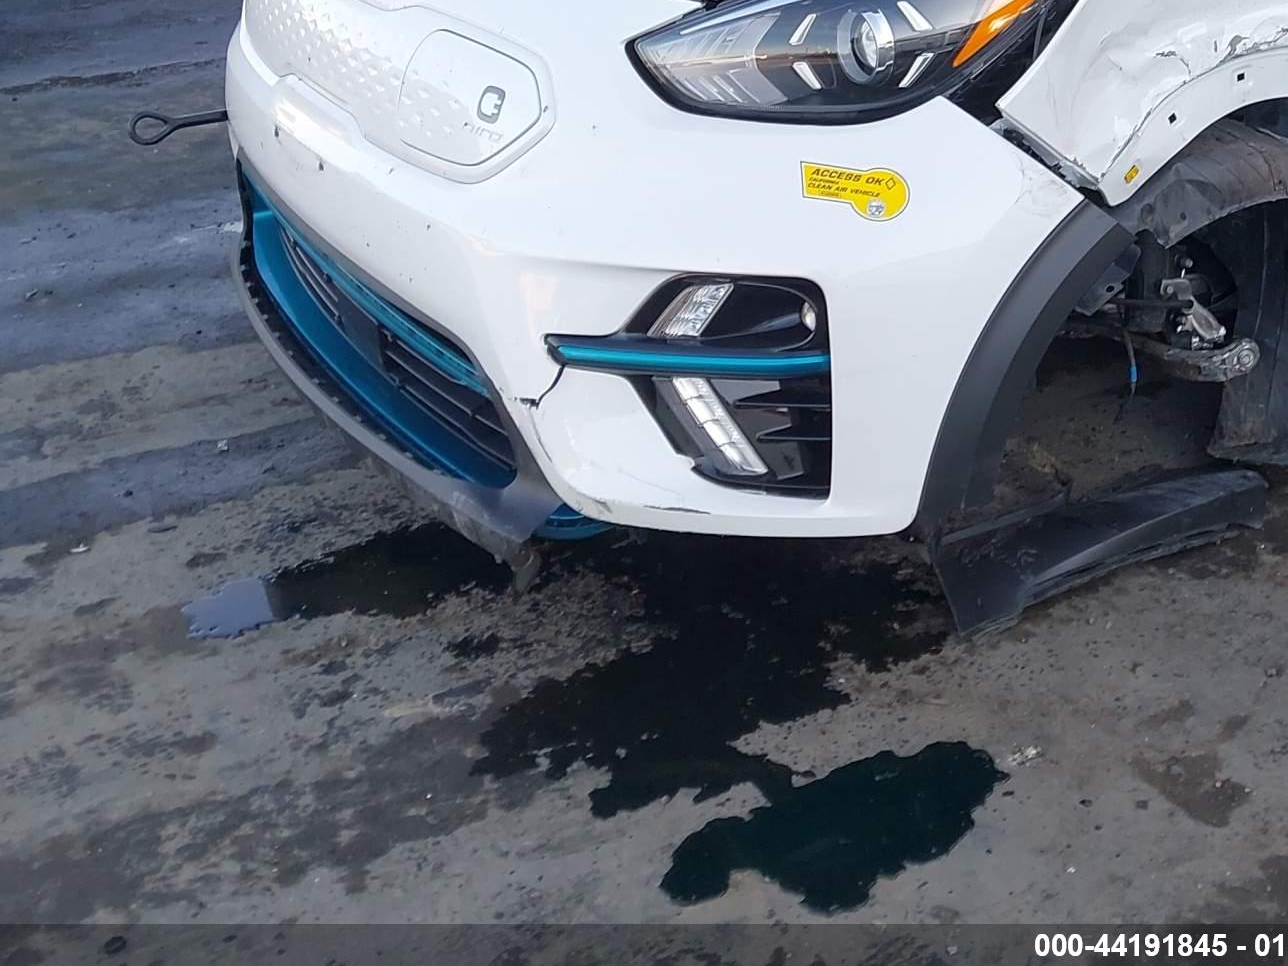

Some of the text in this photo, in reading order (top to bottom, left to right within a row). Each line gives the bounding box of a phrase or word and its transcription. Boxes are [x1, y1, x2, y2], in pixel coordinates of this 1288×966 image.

[811, 168, 886, 186] ACCESS OK
[807, 182, 833, 190] CLEAN
[850, 189, 881, 197] VEHICLE
